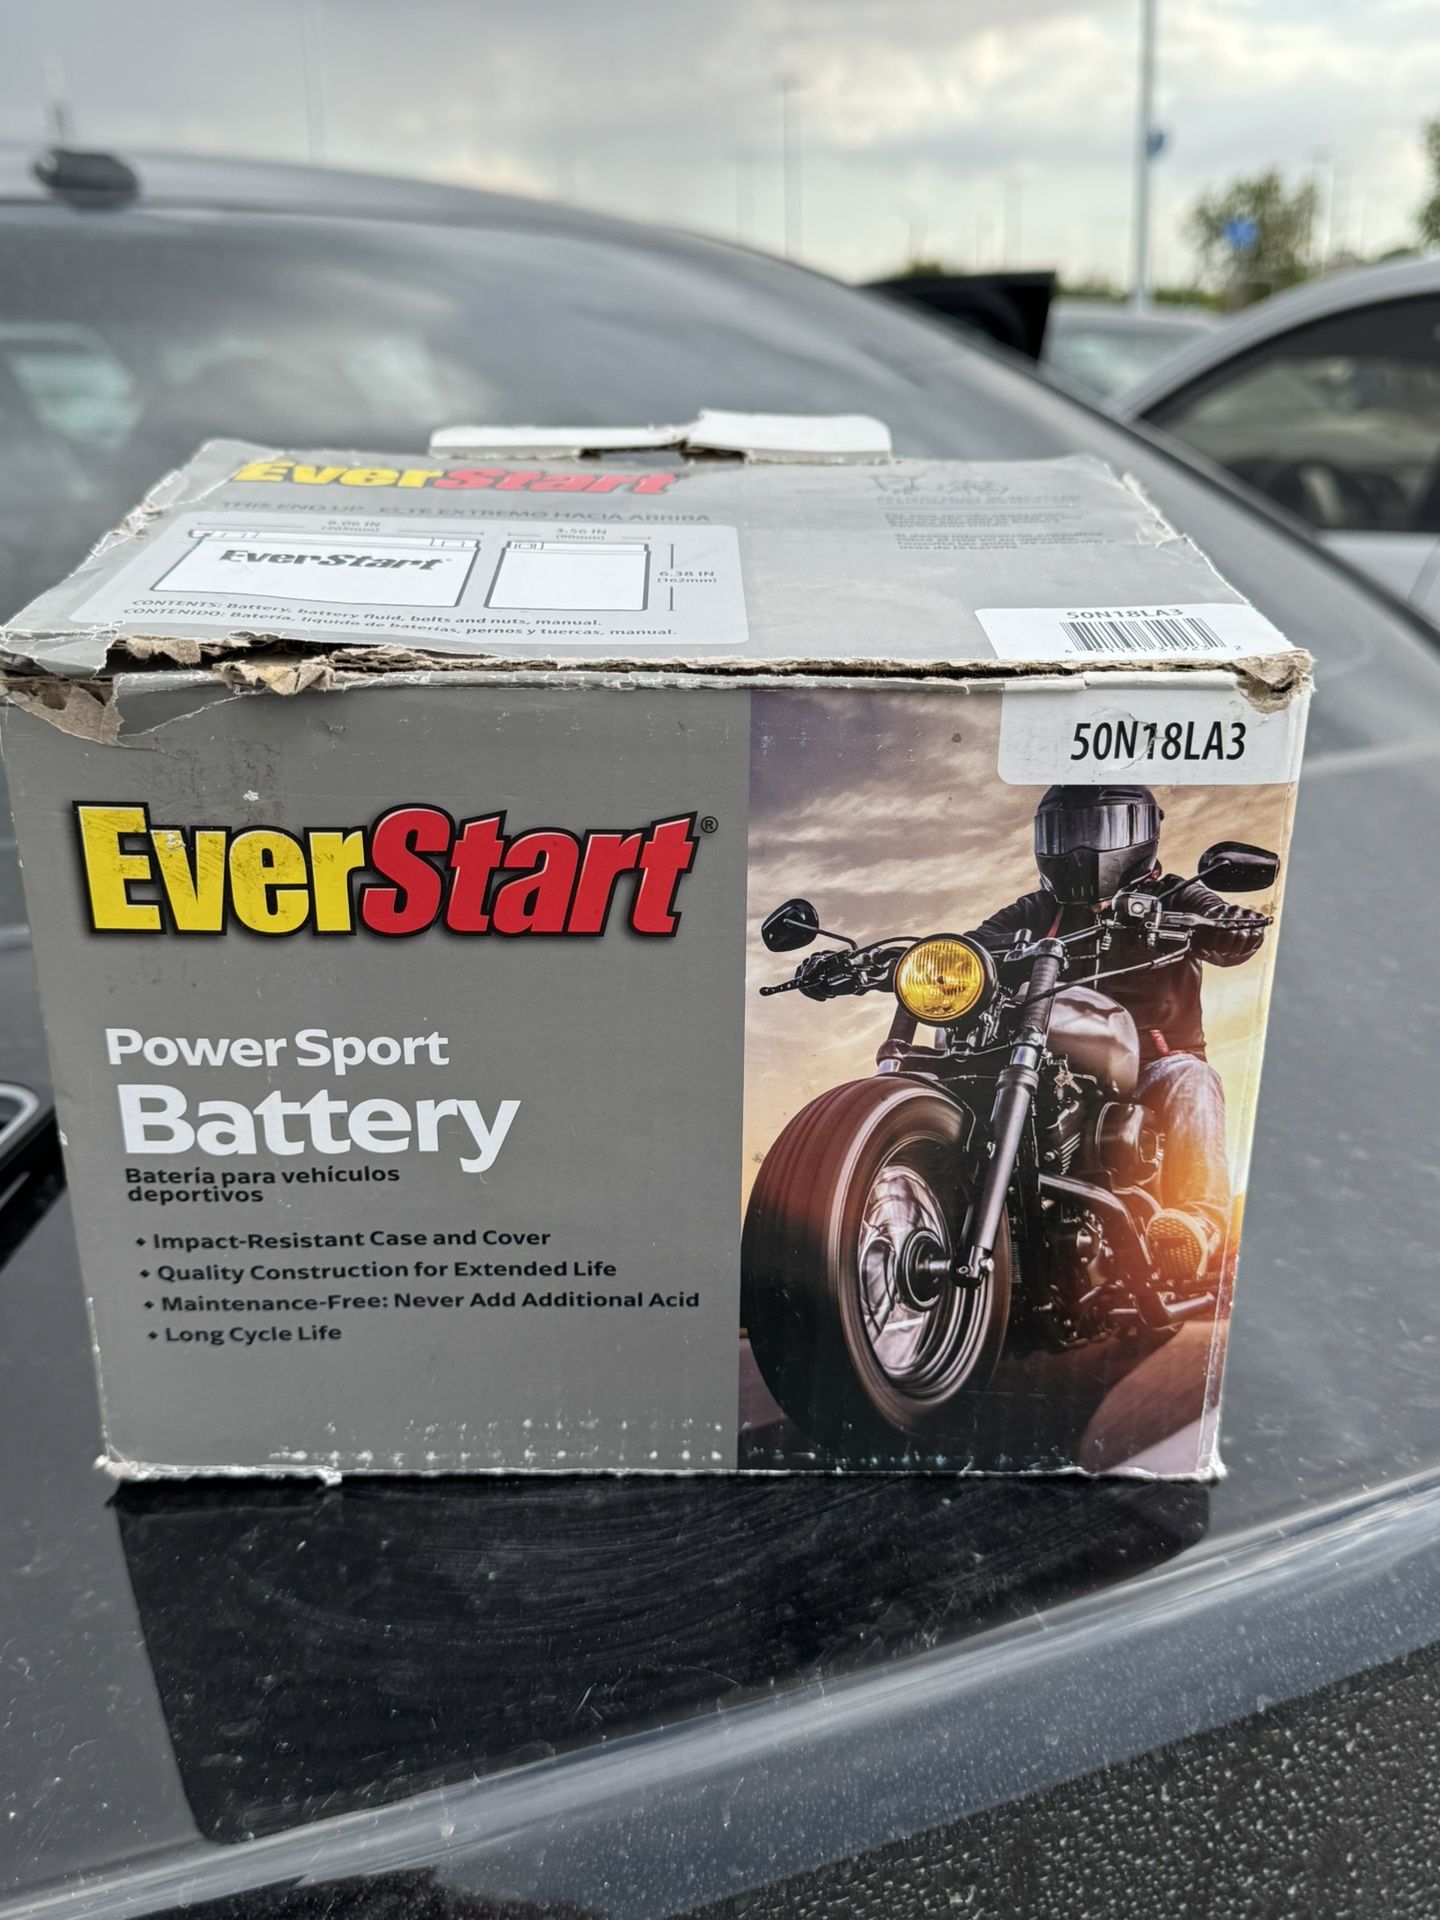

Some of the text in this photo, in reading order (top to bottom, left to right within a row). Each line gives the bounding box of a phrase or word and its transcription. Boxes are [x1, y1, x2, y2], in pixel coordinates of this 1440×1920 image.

[231, 461, 682, 494] EverStart
[222, 501, 364, 513] THIS END UP
[379, 506, 711, 523] ESTE EXTREMO HACIA ARRIBA
[123, 607, 226, 618] CONTENIDO:
[365, 620, 387, 629] de
[466, 627, 524, 636] pernos
[541, 627, 606, 636] tuercas,
[610, 627, 677, 636] manual.
[132, 599, 223, 610] CONTENTS:
[298, 607, 358, 620] battery
[364, 612, 405, 623] fluid,
[411, 614, 450, 624] bolts
[455, 616, 487, 625] and
[491, 617, 531, 626] nuts,
[536, 617, 602, 626] manual.
[1066, 608, 1184, 620] 50N18LA3
[1071, 721, 1246, 760] 50N18LA3
[107, 1028, 451, 1076] Power Sport
[116, 1083, 521, 1174] Battery
[125, 1165, 401, 1189] Batería para vehículos
[127, 1186, 264, 1205] deportivos
[153, 1230, 552, 1252] Impact-Resistant Case and Cover
[157, 1260, 617, 1286] Quality Construction for Extended Life
[161, 1291, 700, 1314] Maintenance-Free: Never Add Additional Acid
[165, 1324, 342, 1346] Long Cycle Life
